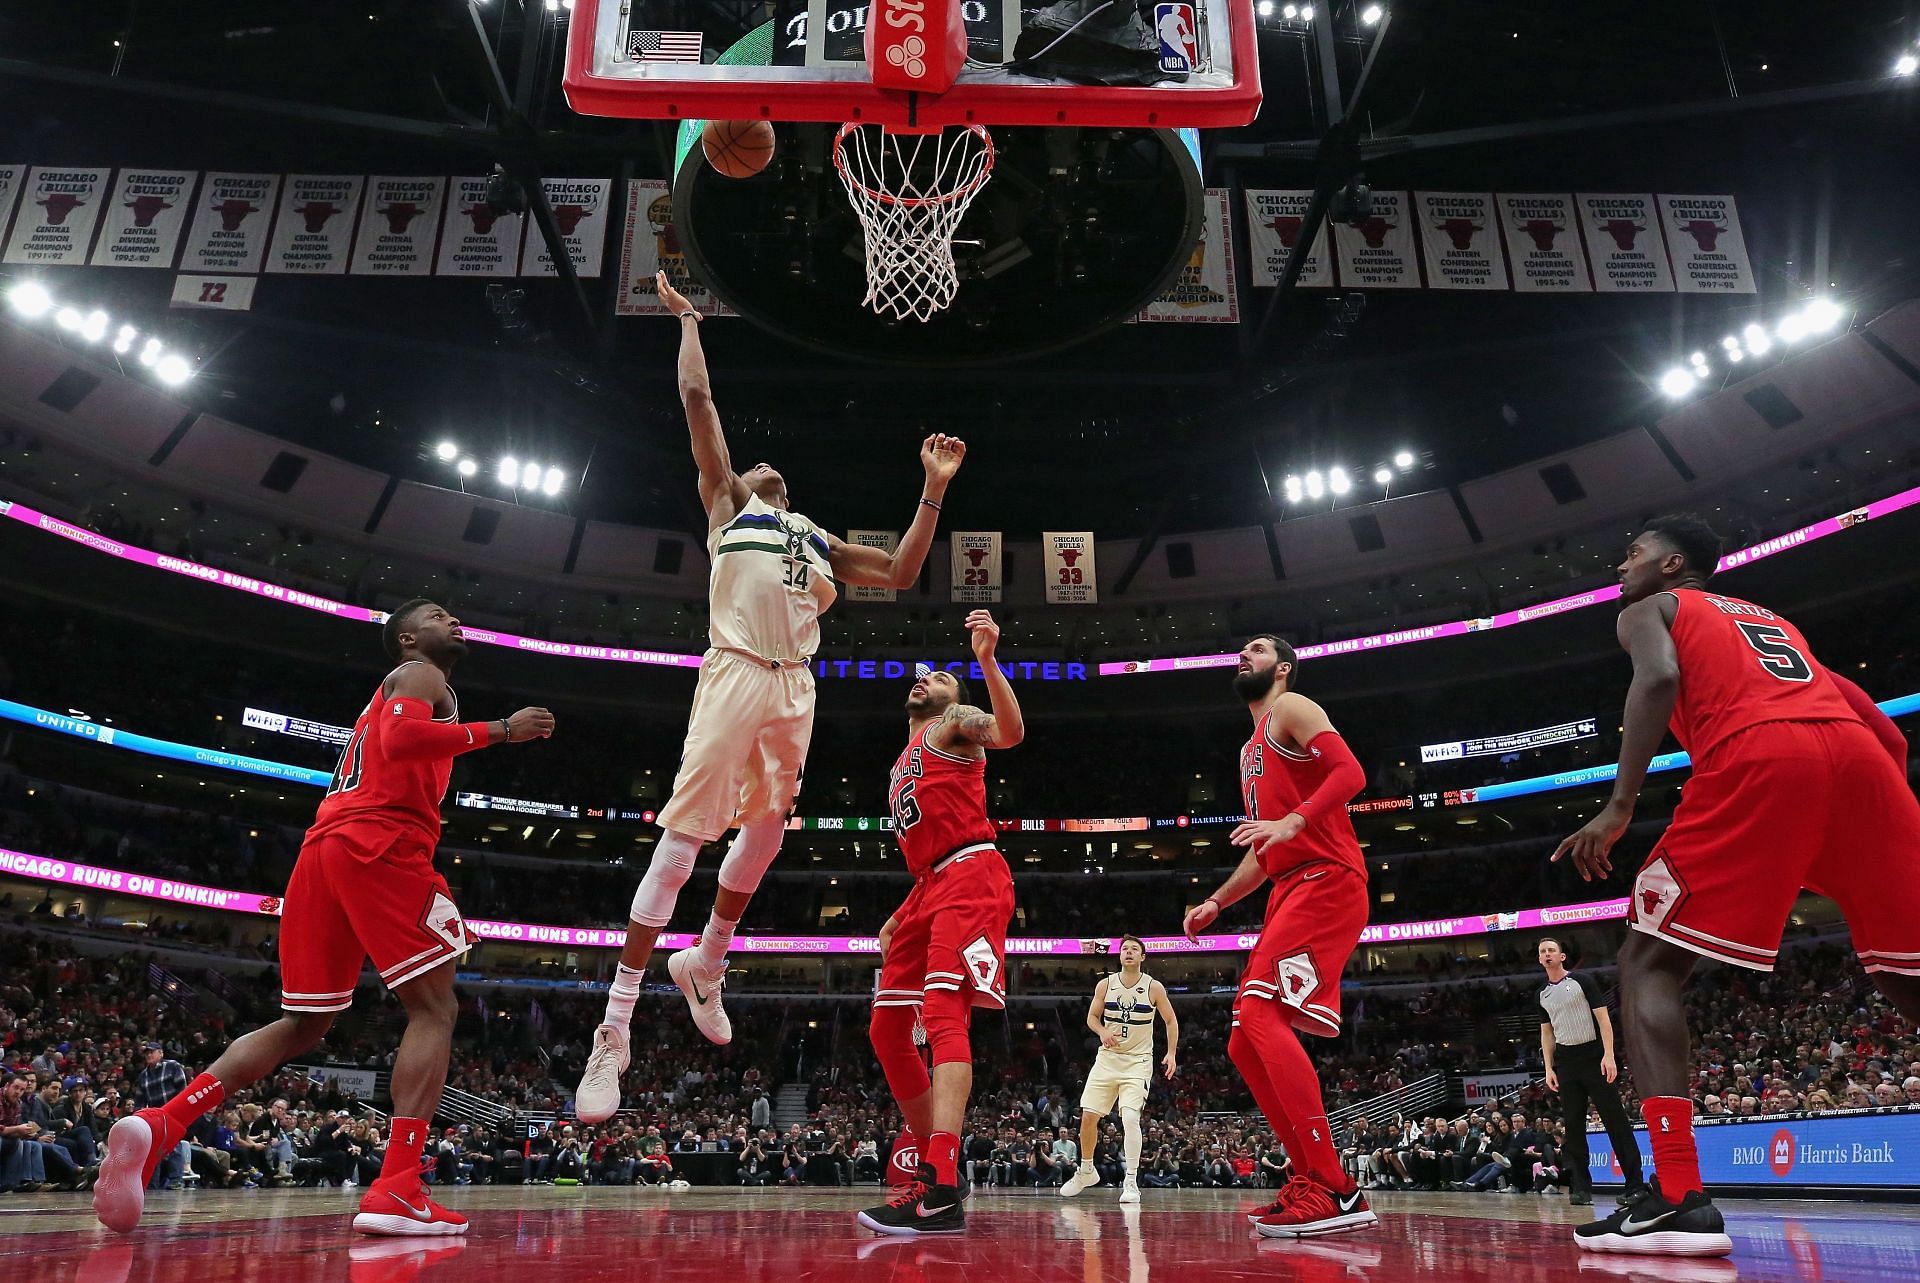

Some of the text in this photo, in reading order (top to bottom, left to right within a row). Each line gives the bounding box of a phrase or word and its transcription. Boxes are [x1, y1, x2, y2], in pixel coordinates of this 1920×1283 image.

[1165, 57, 1183, 69] NBA
[39, 173, 98, 182] CHICAGO
[127, 175, 185, 185] CHICAGO
[44, 183, 88, 193] BULLS
[214, 178, 271, 188] CHICAGO
[294, 180, 352, 190] CHICAGO
[377, 182, 435, 191] CHICAGO
[131, 185, 175, 195] BULLS
[544, 184, 600, 193] CHICAGO
[220, 190, 260, 199] BULLS
[301, 191, 344, 200] BULLS
[382, 191, 425, 201] BULLS
[551, 194, 592, 203] BULLS
[1427, 198, 1484, 207] CHICAGO
[1508, 199, 1564, 208] CHICAGO
[1588, 200, 1645, 209] CHICAGO
[1669, 200, 1726, 209] CHICAGO
[1267, 206, 1306, 215] BULLS
[1438, 209, 1478, 217] BULLS
[1520, 210, 1559, 218] BULLS
[1599, 210, 1639, 218] BULLS
[1680, 210, 1721, 219] BULLS
[207, 241, 245, 249] DIVISION
[463, 236, 498, 244] CENTRAL
[23, 243, 73, 251] CHAMPIONS
[460, 245, 498, 253] DIVISION
[198, 250, 248, 258] CHAMPIONS
[282, 253, 332, 261] CHAMPIONS
[1440, 260, 1490, 268] CONFERENCE
[1690, 272, 1739, 280] CHAMPIONS
[198, 282, 227, 302] 72
[1726, 551, 1747, 566] ON
[157, 556, 219, 580] CHICAGO
[223, 572, 259, 592] RUNS
[263, 584, 284, 599] ON
[782, 559, 809, 590] 34
[965, 568, 989, 585] 23
[1058, 568, 1083, 585] 33
[465, 631, 496, 642] DONUTS
[1327, 640, 1359, 653] RUNS
[1363, 636, 1382, 648] ON
[519, 640, 570, 655] CHICAGO
[574, 647, 607, 658] RUNS
[611, 649, 628, 660] ON
[1734, 620, 1814, 683] 5
[820, 661, 905, 678] ITED
[36, 712, 97, 736] UNITED
[308, 726, 320, 735] THE
[1484, 741, 1498, 749] THE
[1498, 737, 1531, 748] NETWORK
[196, 752, 311, 780] Chicago's Hometown Airline
[1555, 767, 1618, 784] Chicago's Home
[1418, 790, 1459, 801] 12/15 80%
[492, 796, 517, 805] PURDUE
[518, 799, 565, 810] BOILERMAKERS
[1347, 798, 1411, 813] FREE THROWS
[491, 803, 547, 815] INDIANA HOOSIERS
[587, 809, 603, 817] 2nd
[622, 812, 640, 820] BMO
[1191, 816, 1223, 825] HARRIS
[818, 818, 844, 830] BUCKS
[1021, 820, 1045, 830] BULLS
[0, 853, 66, 878] HICAGO
[72, 867, 122, 889] RUNS
[128, 877, 155, 896] ON
[528, 927, 600, 943] RUNS ON
[1360, 927, 1383, 941] ON
[791, 941, 827, 950] DONUTS
[1005, 940, 1057, 952] UNKIN'
[1122, 1026, 1129, 1038] 8
[1733, 1141, 1895, 1165] BMO Harris Bank
